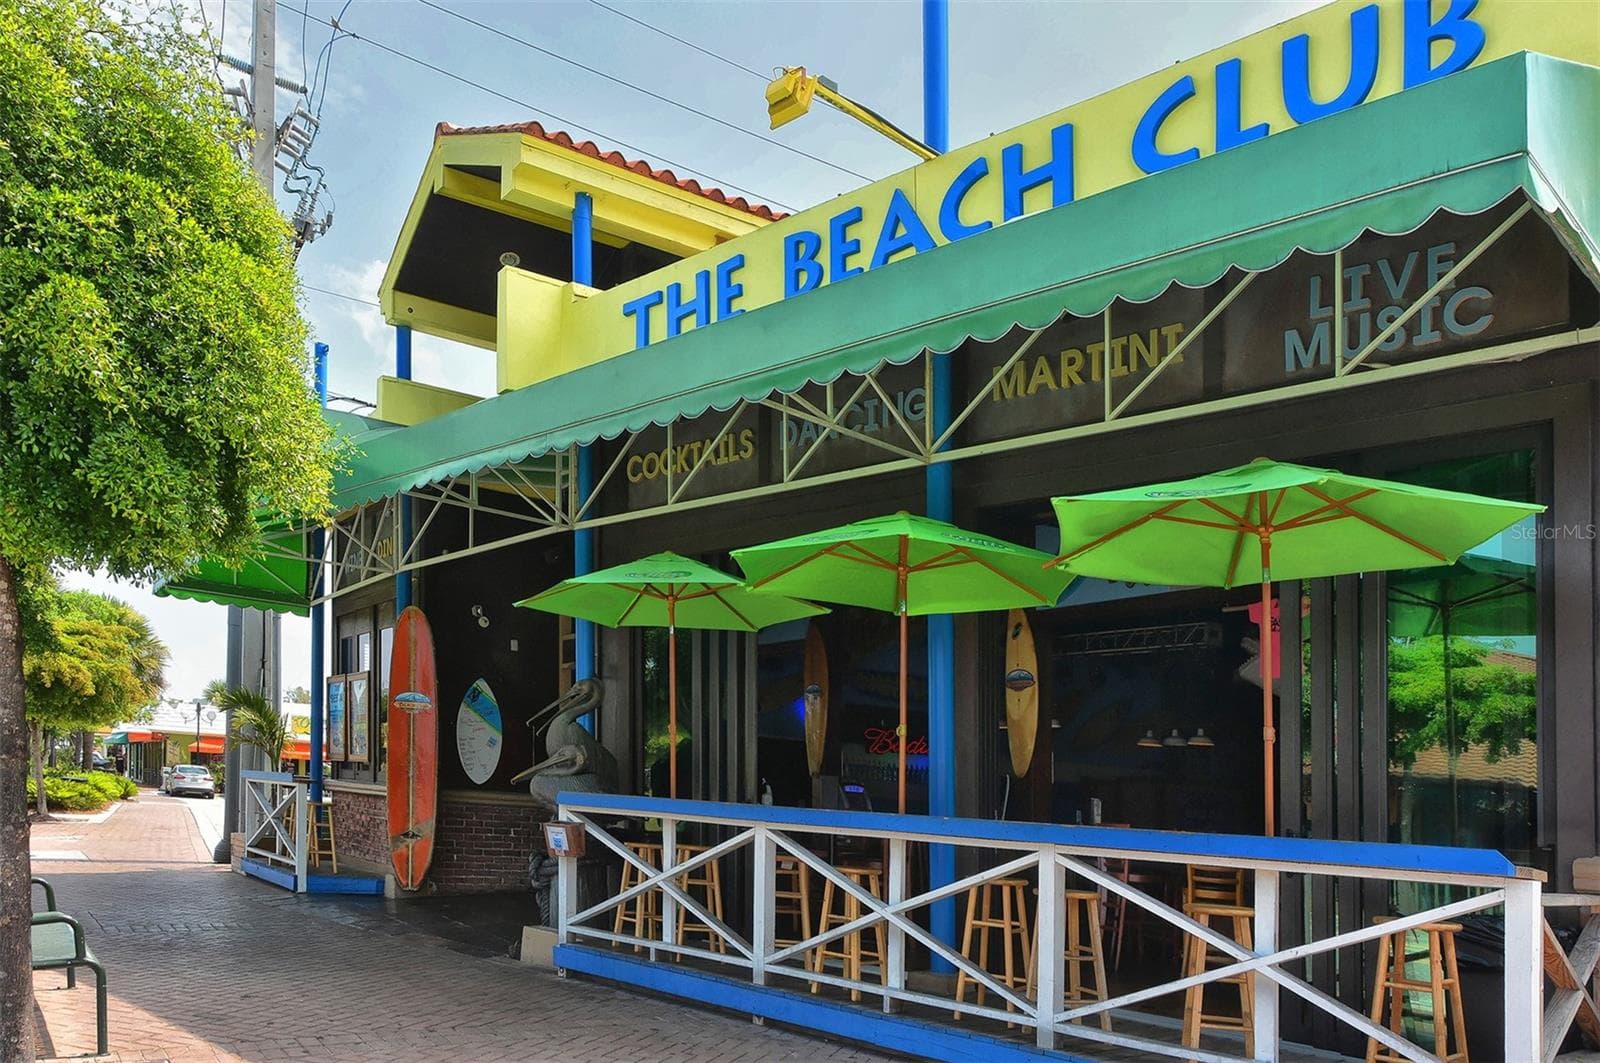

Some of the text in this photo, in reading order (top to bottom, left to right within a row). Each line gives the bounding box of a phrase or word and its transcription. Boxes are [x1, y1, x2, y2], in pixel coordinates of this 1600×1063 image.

[624, 0, 1487, 348] THE BEACH CLUB
[1310, 241, 1457, 320] LIVE
[992, 322, 1185, 401] MARTINI
[1284, 285, 1495, 372] MUSIC
[626, 428, 754, 483] COCKTAILS
